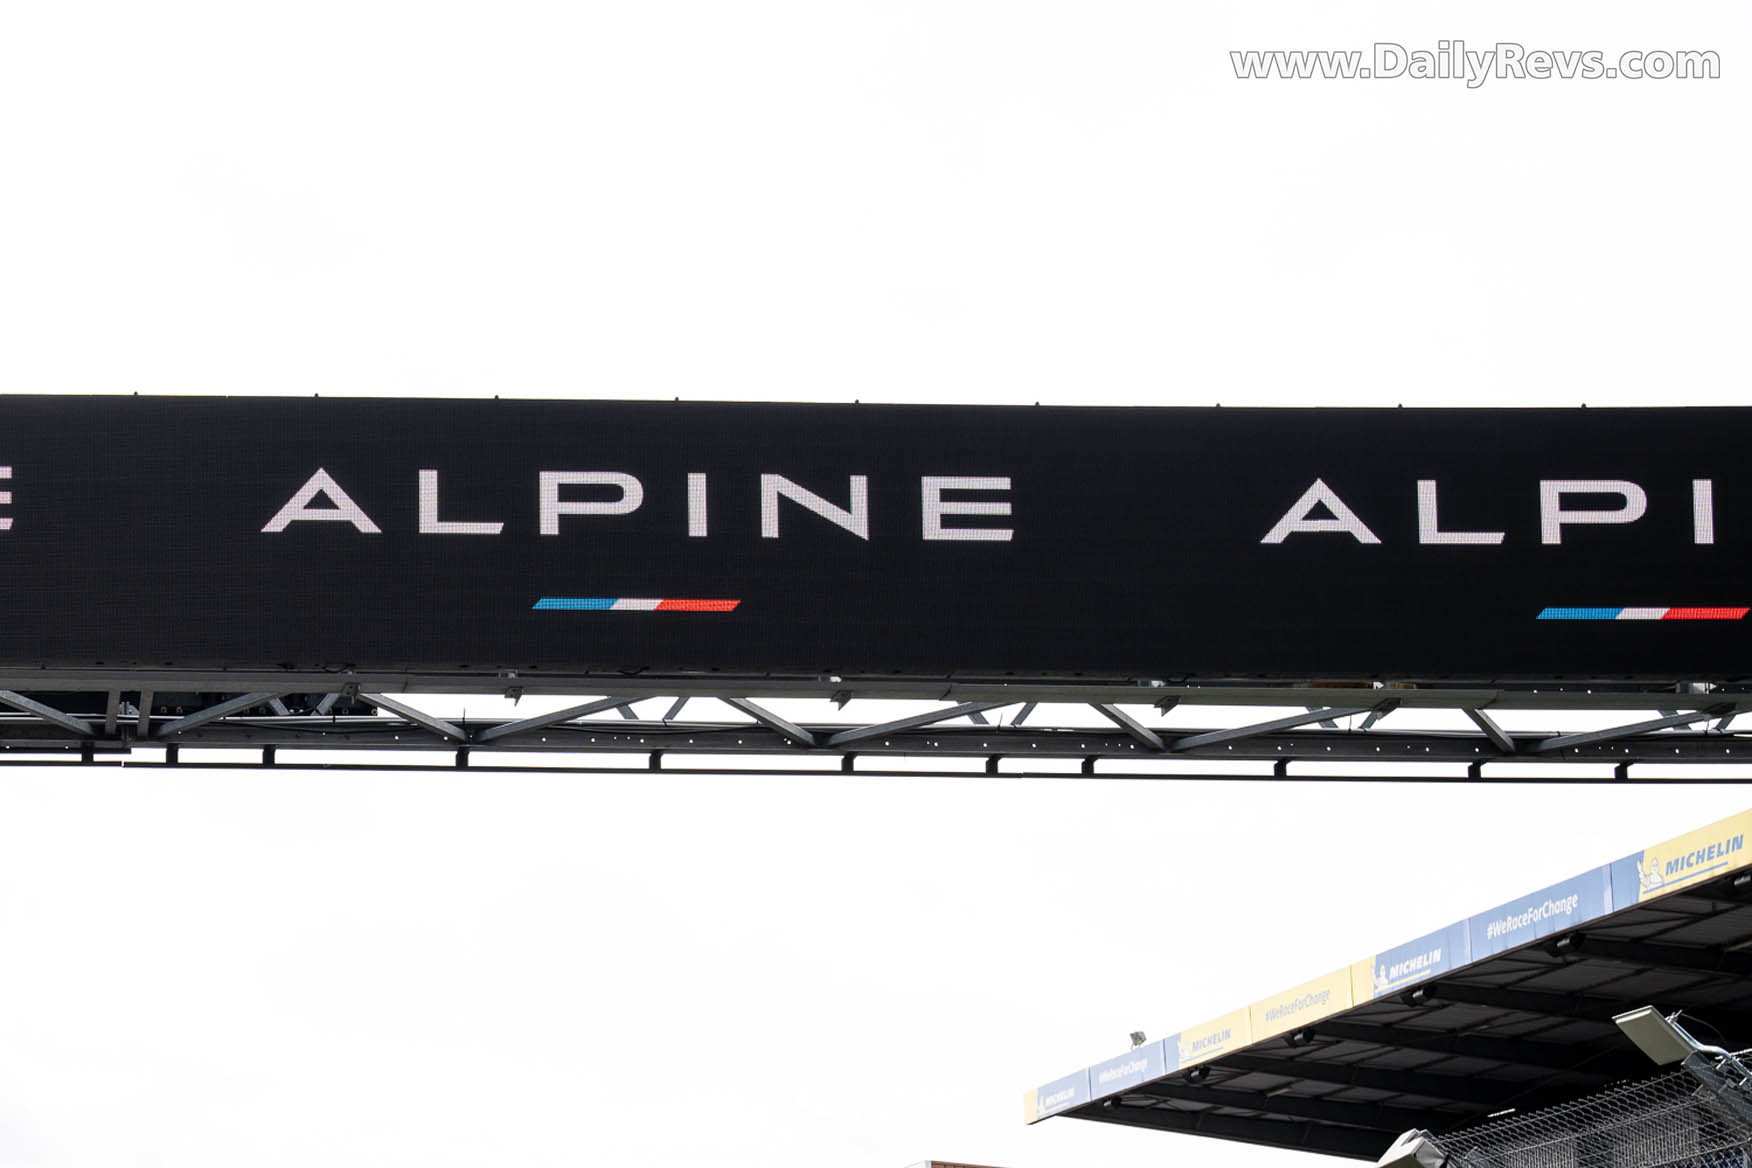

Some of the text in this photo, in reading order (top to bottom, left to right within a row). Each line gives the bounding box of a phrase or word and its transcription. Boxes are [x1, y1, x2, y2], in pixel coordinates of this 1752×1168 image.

[261, 468, 1014, 542] ALPINE
[1261, 478, 1714, 545] ALPI
[1665, 834, 1744, 876] MICHELIN
[1486, 893, 1579, 940] #WeRaceForChange
[1389, 948, 1442, 979] MICHELIN
[1191, 1028, 1232, 1052] MICHELIN
